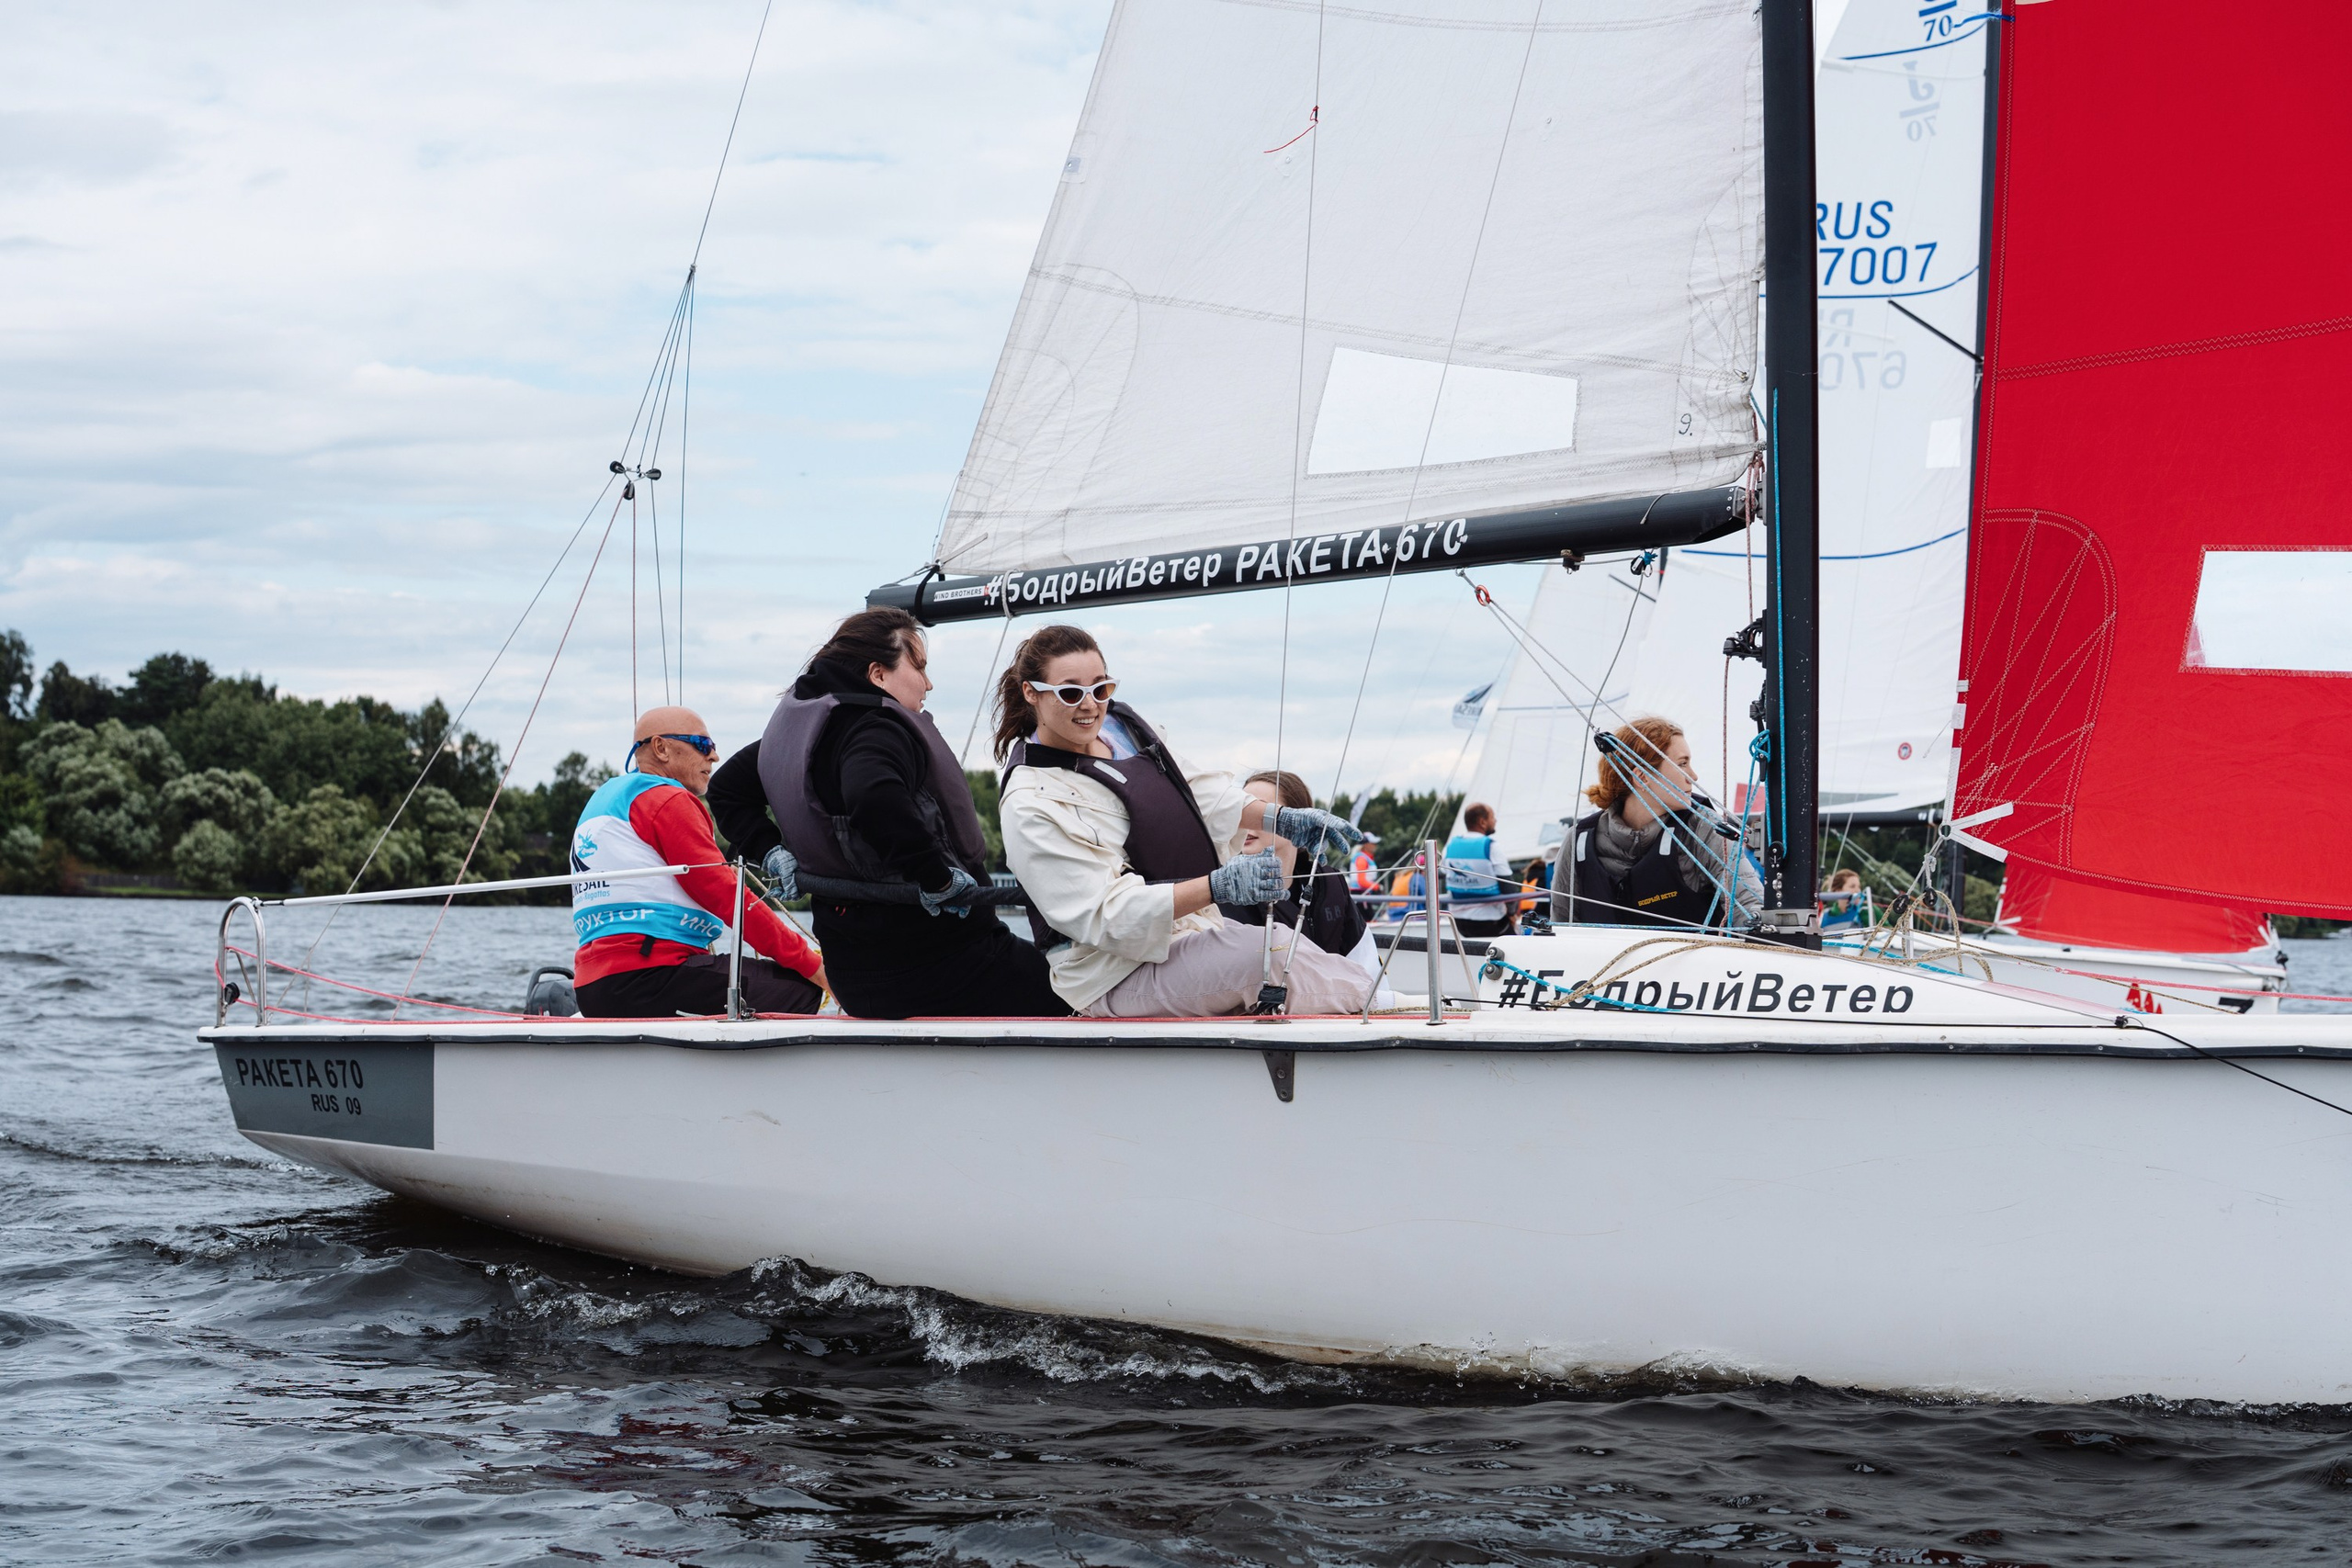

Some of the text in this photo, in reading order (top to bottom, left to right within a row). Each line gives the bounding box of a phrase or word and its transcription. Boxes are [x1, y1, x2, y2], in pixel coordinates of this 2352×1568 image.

[1923, 15, 1953, 42] 70
[984, 553, 1223, 606] #БодрыйВетер
[1396, 518, 1468, 562] 670
[950, 588, 982, 598] BROTHERS
[680, 912, 722, 938] ИНС
[324, 1059, 364, 1089] 670
[311, 1093, 362, 1115] RUS 09
